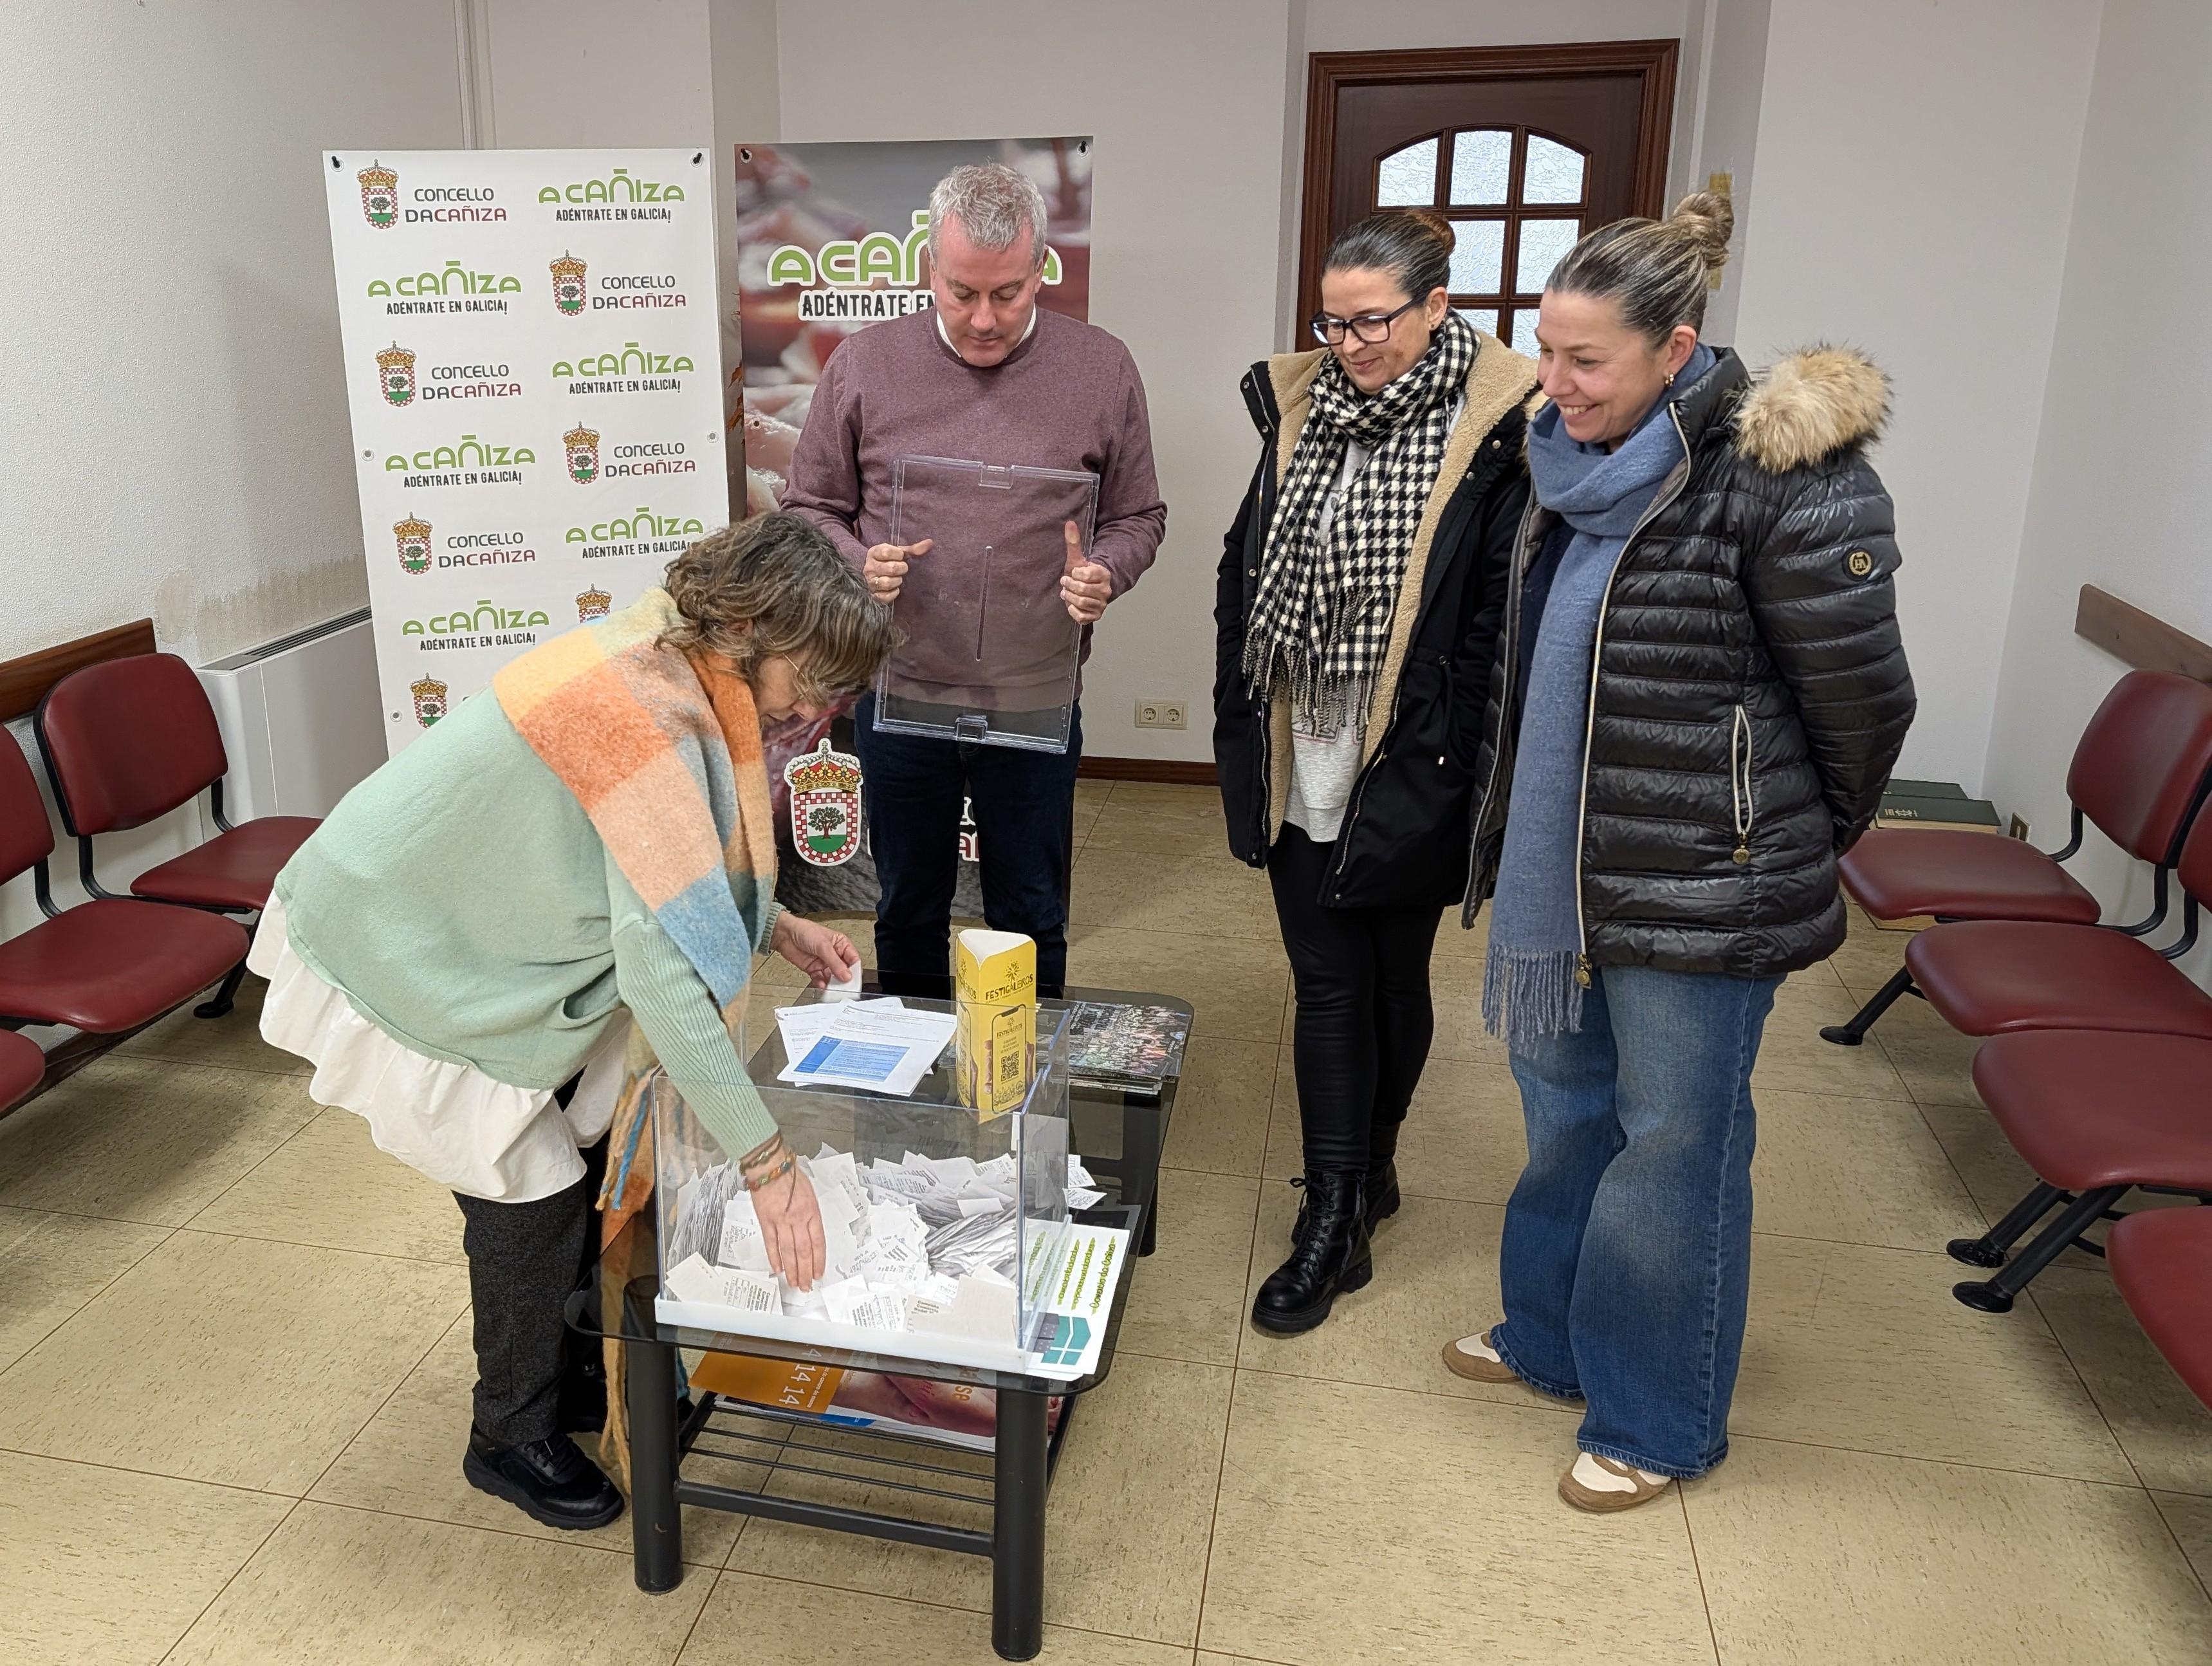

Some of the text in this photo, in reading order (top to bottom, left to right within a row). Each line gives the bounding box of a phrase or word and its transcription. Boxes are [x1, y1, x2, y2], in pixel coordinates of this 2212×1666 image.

[414, 188, 495, 202] CONCELLO
[556, 207, 672, 223] ADÉNTRATE EN GALICIA!
[771, 250, 812, 282] A
[602, 275, 676, 290] CONCELLO
[387, 299, 508, 315] ADÉNTRATE EN GALICIA!
[802, 292, 908, 317] ADÉNTRATE
[431, 364, 510, 380] CONCELLO
[569, 378, 681, 394] ADÉNTRATE EN GALICIA!
[614, 442, 685, 458] CONCELLO
[403, 470, 522, 488] ADÉNTRATE EN GALICIA!
[447, 532, 524, 549] CONCELLO
[582, 544, 636, 559] ADÉNTRATE
[638, 543, 650, 555] EN
[420, 632, 537, 651] ADÉNTRATE EN GALICIA!
[779, 1364, 816, 1405] 14 14
